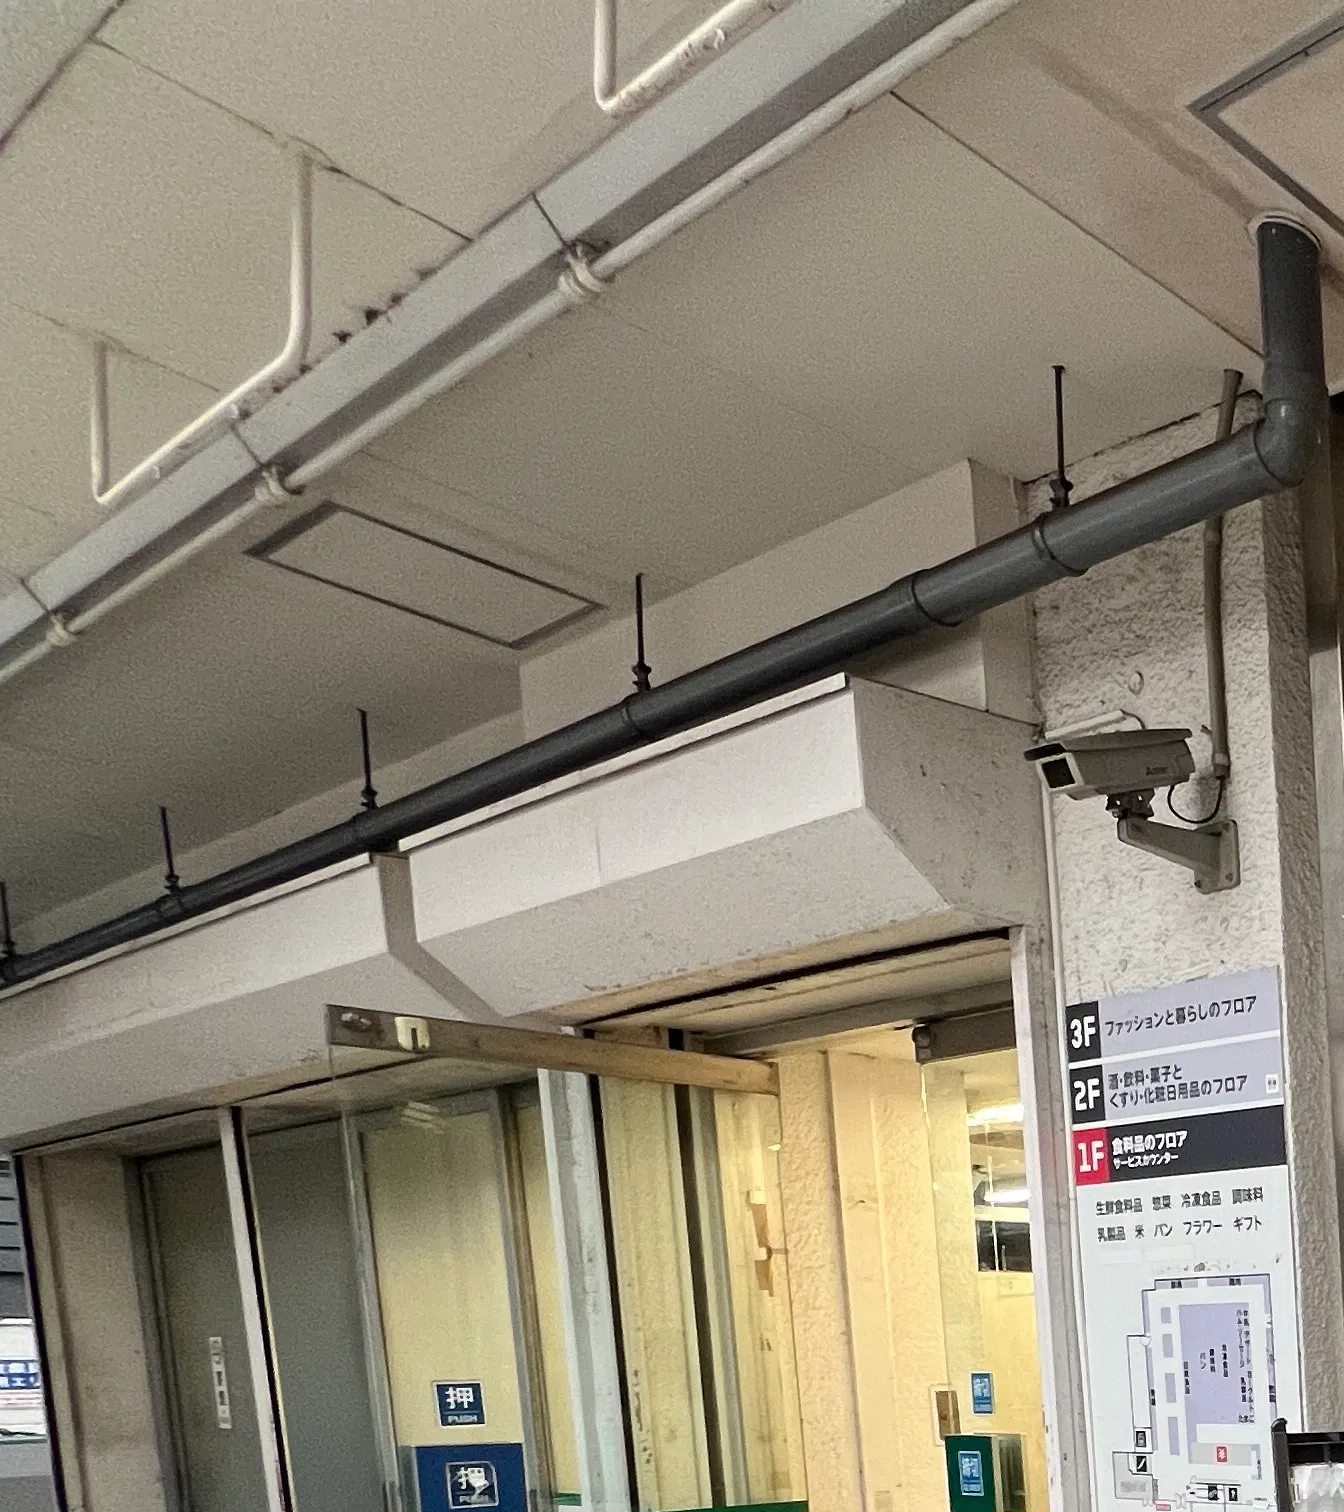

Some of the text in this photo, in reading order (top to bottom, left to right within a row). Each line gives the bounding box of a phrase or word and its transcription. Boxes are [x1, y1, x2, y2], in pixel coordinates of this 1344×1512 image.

[1070, 996, 1257, 1049] 3F ファッションと暮らしのフロア
[1073, 1078, 1100, 1111] 2F
[1109, 1075, 1248, 1108] くすり・化粧日用品のフロア
[1077, 1130, 1188, 1172] 1F 食料品のフロア
[1113, 1152, 1178, 1169] サービスカウンター
[1154, 1223, 1173, 1237] パン
[1183, 1220, 1222, 1235] フラワー
[1233, 1215, 1262, 1231] ギフト
[445, 1387, 475, 1410] 押
[448, 1415, 478, 1423] PUSH
